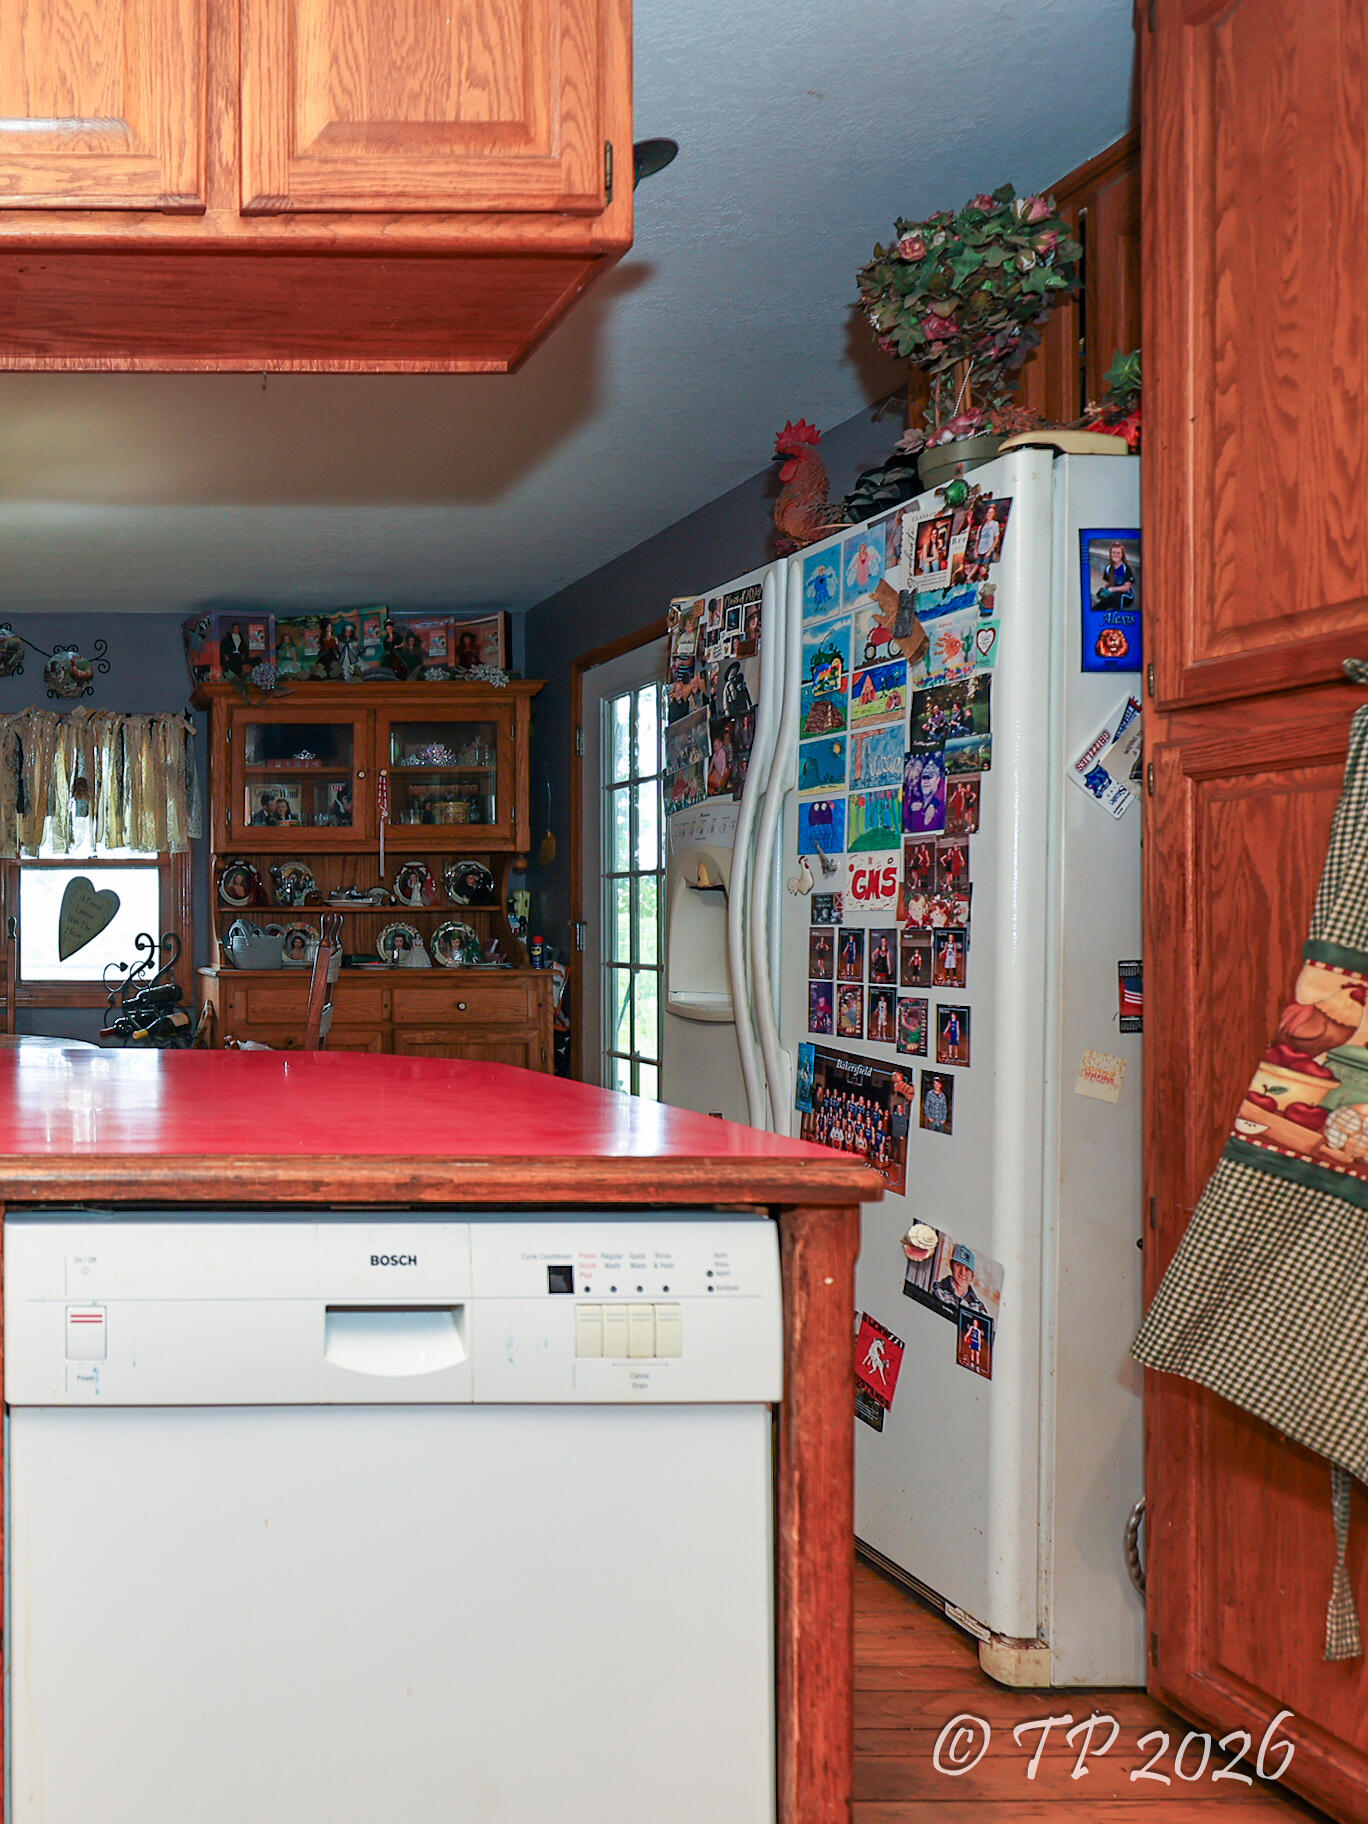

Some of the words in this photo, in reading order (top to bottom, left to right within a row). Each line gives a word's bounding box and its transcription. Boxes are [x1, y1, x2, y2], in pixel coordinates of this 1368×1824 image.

[1075, 729, 1111, 773] GRIZZLIES
[851, 867, 897, 900] GMS
[370, 1255, 417, 1266] BOSCH
